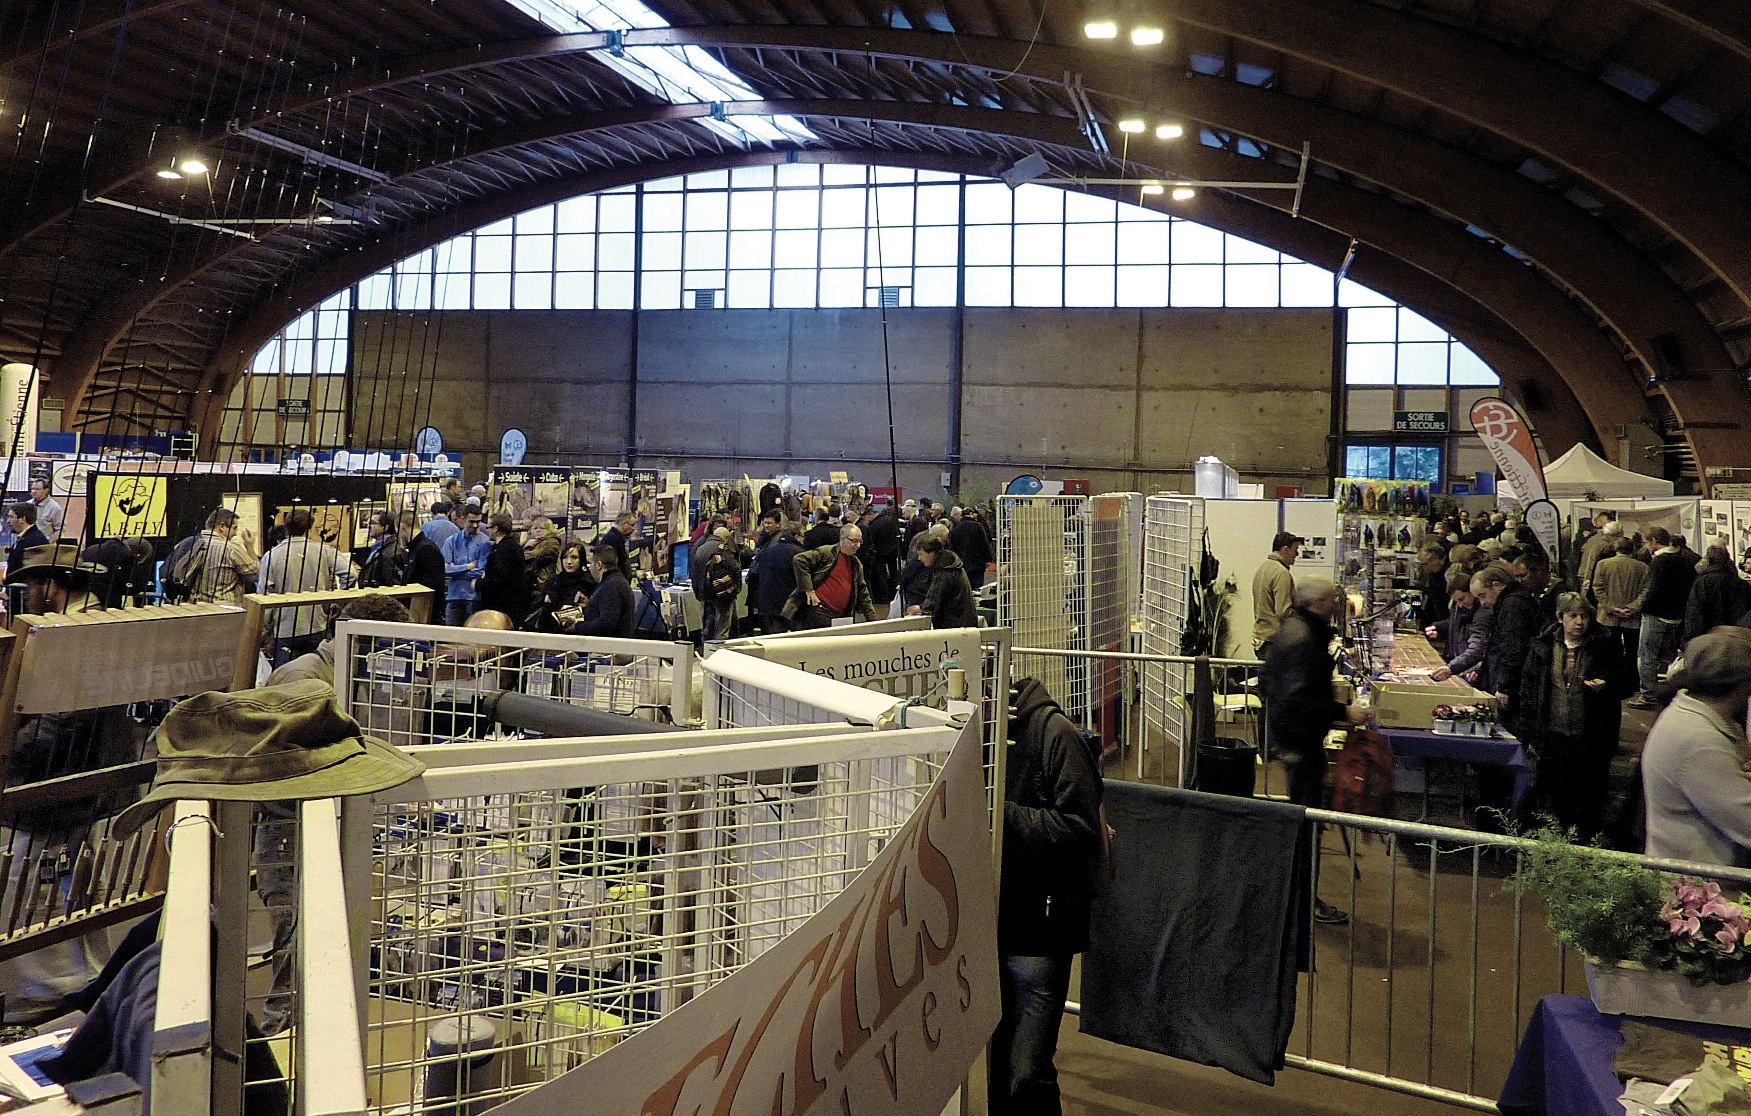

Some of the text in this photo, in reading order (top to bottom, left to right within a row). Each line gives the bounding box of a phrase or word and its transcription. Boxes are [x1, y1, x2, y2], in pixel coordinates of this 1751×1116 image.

[1407, 412, 1435, 421] SORTIE
[1396, 421, 1446, 430] DE SECOURS
[844, 647, 931, 680] mouches
[938, 641, 960, 663] de
